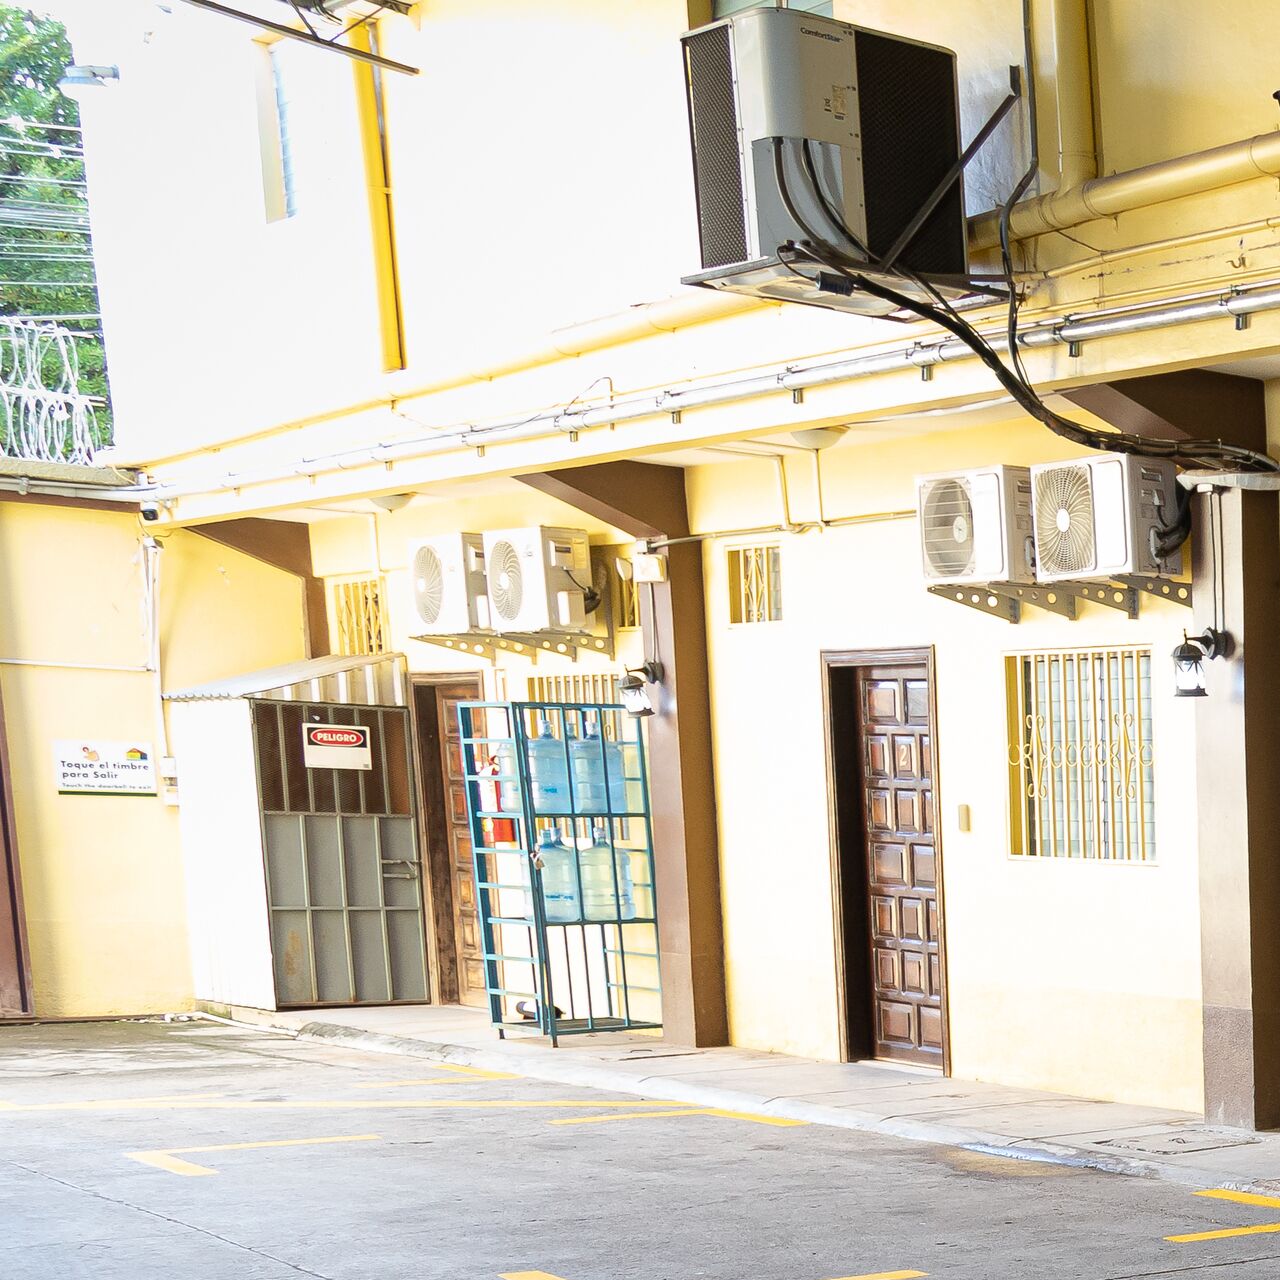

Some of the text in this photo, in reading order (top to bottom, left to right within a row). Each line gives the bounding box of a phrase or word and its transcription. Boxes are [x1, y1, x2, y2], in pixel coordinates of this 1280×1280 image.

[317, 732, 357, 742] PELIGRO
[900, 744, 908, 767] 2
[61, 761, 94, 769] Toque
